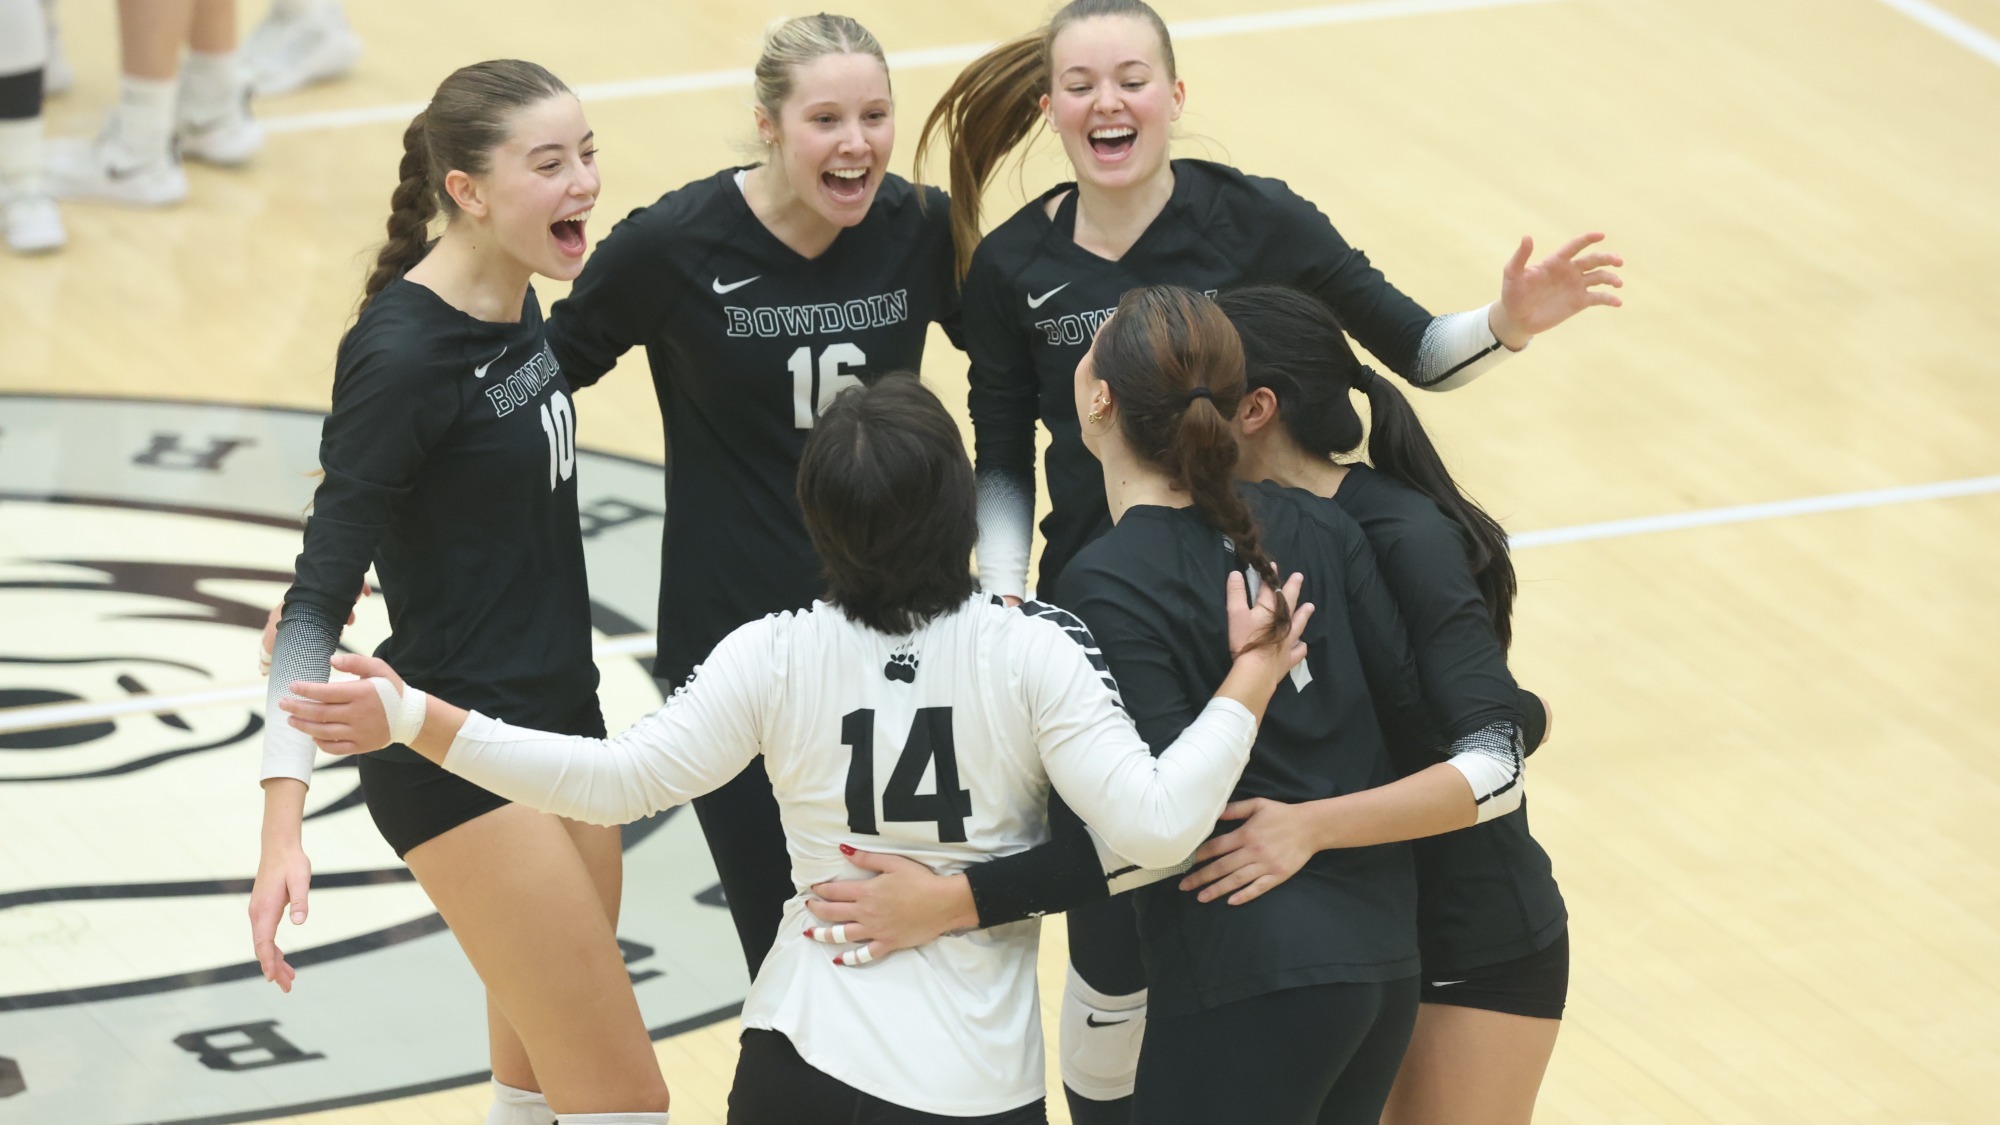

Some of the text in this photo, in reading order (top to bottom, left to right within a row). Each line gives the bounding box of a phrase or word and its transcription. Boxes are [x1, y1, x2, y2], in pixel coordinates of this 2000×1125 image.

[724, 289, 908, 338] BOWDOIN
[540, 389, 575, 493] 10
[840, 705, 972, 843] 14
